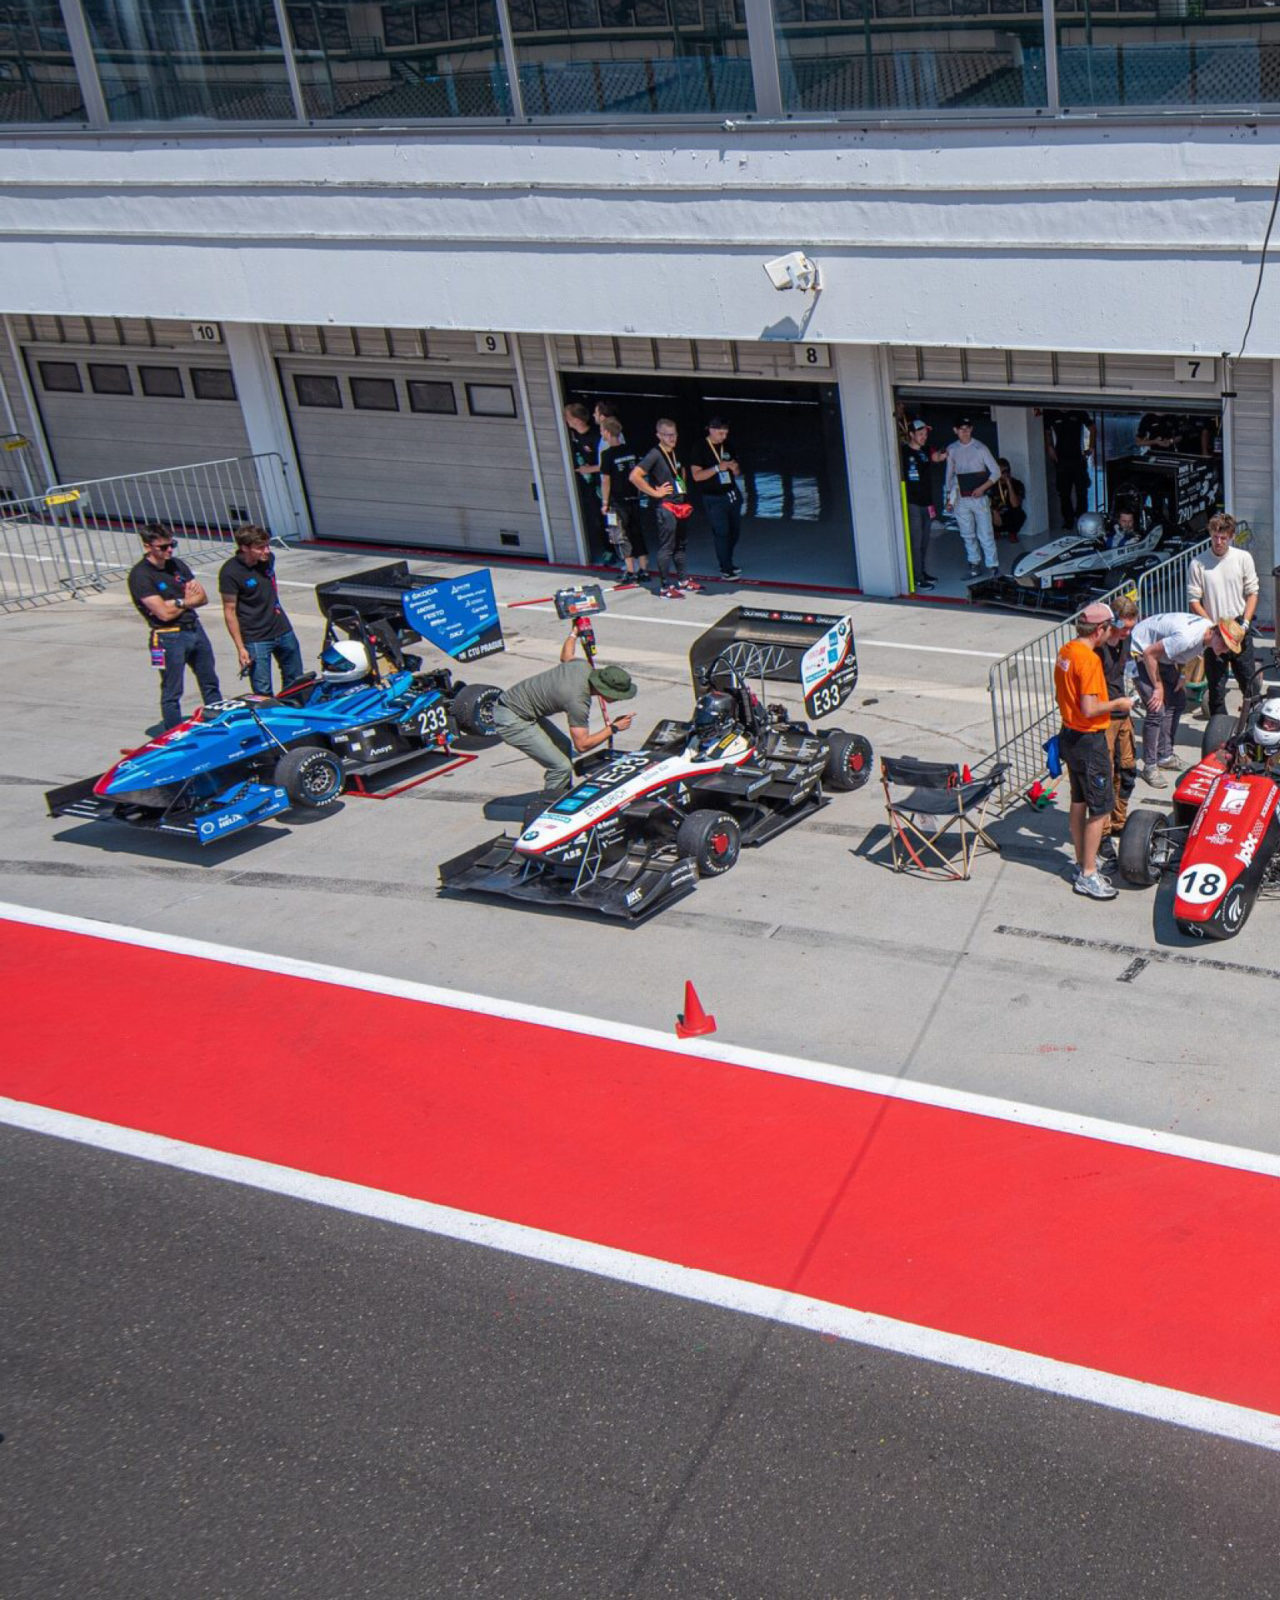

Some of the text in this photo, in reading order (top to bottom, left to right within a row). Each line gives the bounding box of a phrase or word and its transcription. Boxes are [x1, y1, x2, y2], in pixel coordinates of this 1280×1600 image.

[198, 326, 214, 340] 10
[485, 336, 496, 351] 9
[806, 347, 818, 363] 8
[1188, 361, 1200, 378] 7
[813, 683, 841, 716] E33
[417, 705, 448, 735] 233
[593, 757, 650, 784] E33
[1181, 871, 1222, 896] 18
